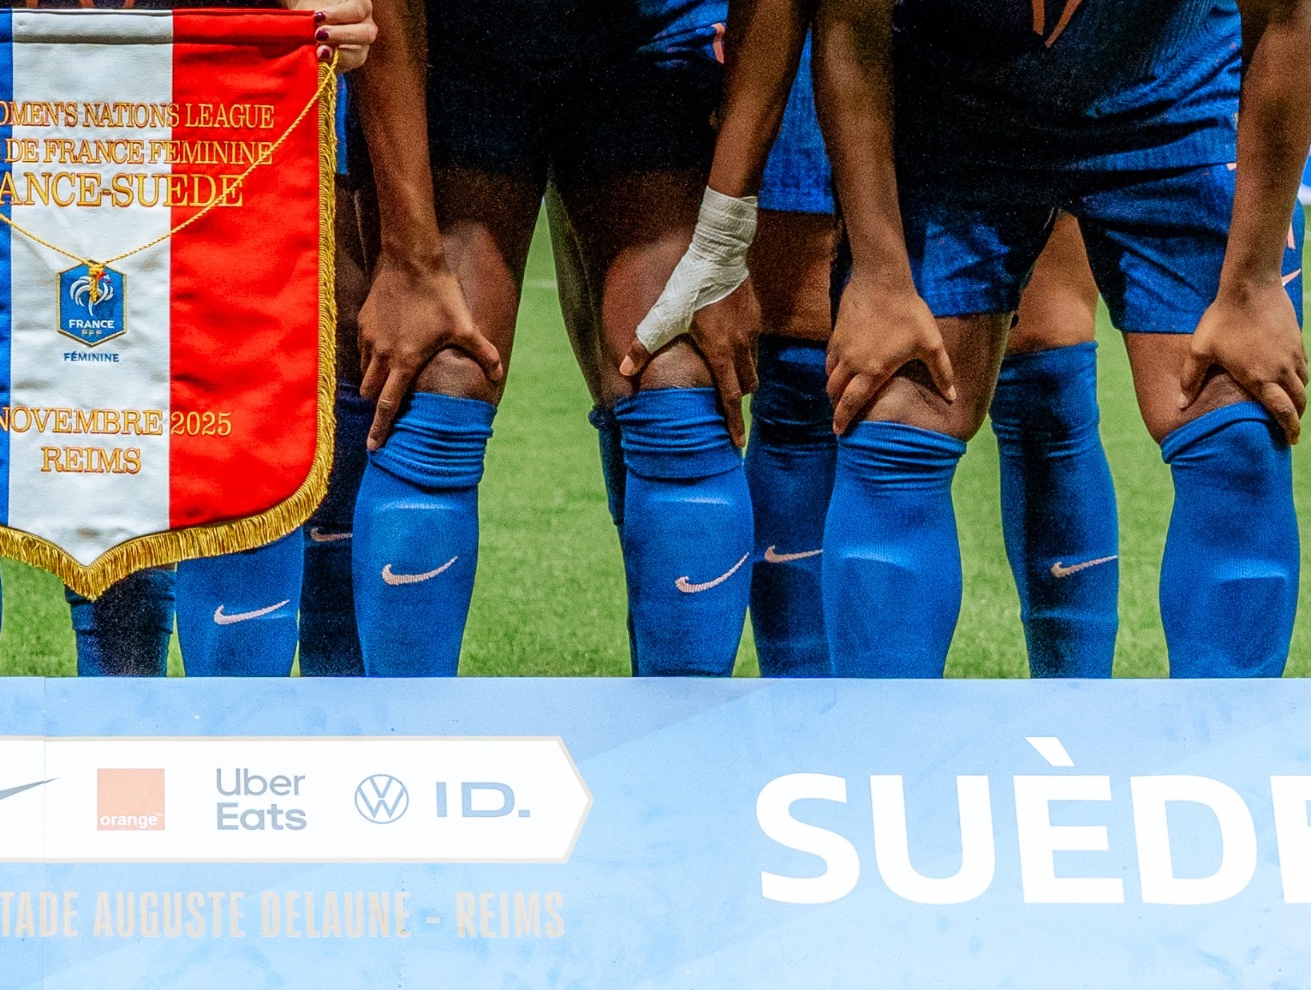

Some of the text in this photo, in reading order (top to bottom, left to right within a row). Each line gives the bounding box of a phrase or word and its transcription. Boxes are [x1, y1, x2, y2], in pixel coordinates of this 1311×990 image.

[83, 101, 180, 128] NATIONS
[185, 103, 275, 129] LEAGUE
[5, 138, 39, 163] DE
[44, 138, 144, 164] FRANCE
[148, 140, 273, 165] FEMININE
[68, 319, 115, 329] FRANCE
[63, 351, 120, 363] FÉMININE
[170, 411, 232, 436] 2025
[40, 446, 142, 474] REIMS
[216, 768, 306, 796] Uber
[216, 802, 307, 830] Eats
[93, 890, 246, 939] AUGUSTE
[261, 890, 411, 939] DELAUNE
[457, 891, 565, 939] REIMS
